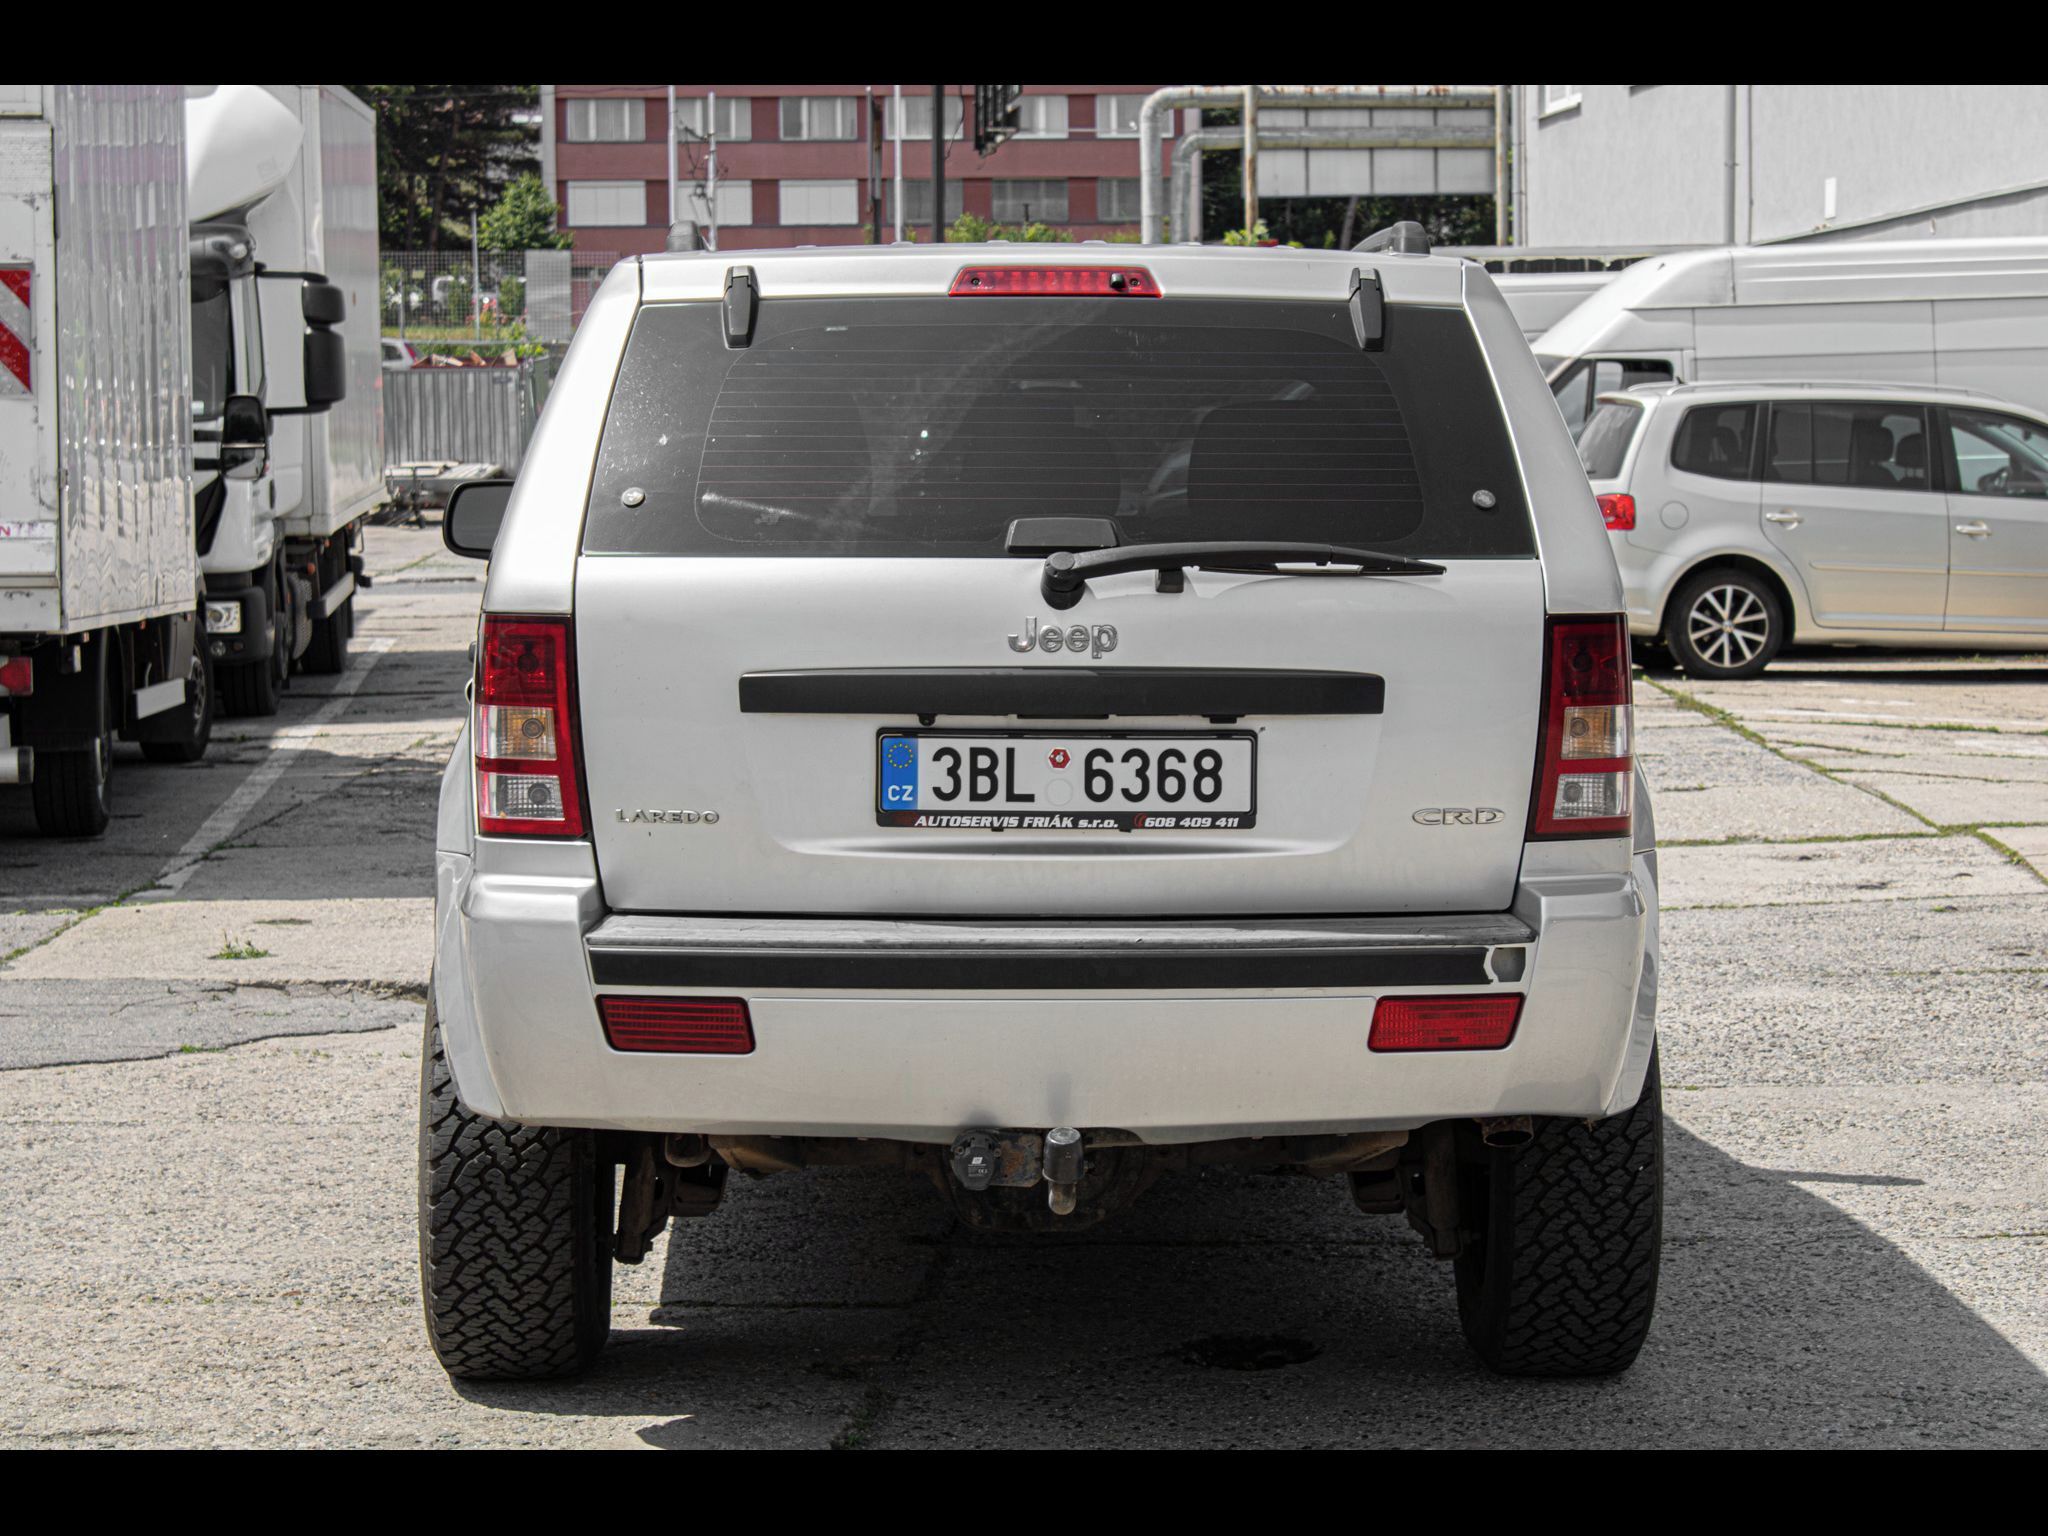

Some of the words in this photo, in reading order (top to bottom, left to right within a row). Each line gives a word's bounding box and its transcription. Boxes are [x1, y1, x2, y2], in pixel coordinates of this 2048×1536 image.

[1008, 616, 1118, 659] Jeep
[932, 747, 1035, 803] 3BL
[1084, 748, 1223, 803] 6368
[888, 785, 913, 801] CZ
[615, 809, 720, 824] LAREDO
[914, 815, 1019, 828] AUTOSERVIS
[1022, 814, 1073, 829] FRIÁK
[1078, 817, 1119, 829] s.r.o.
[1144, 817, 1176, 828] 608
[1179, 817, 1212, 828] 409
[1215, 817, 1239, 828] 411
[1412, 807, 1505, 825] CRD
